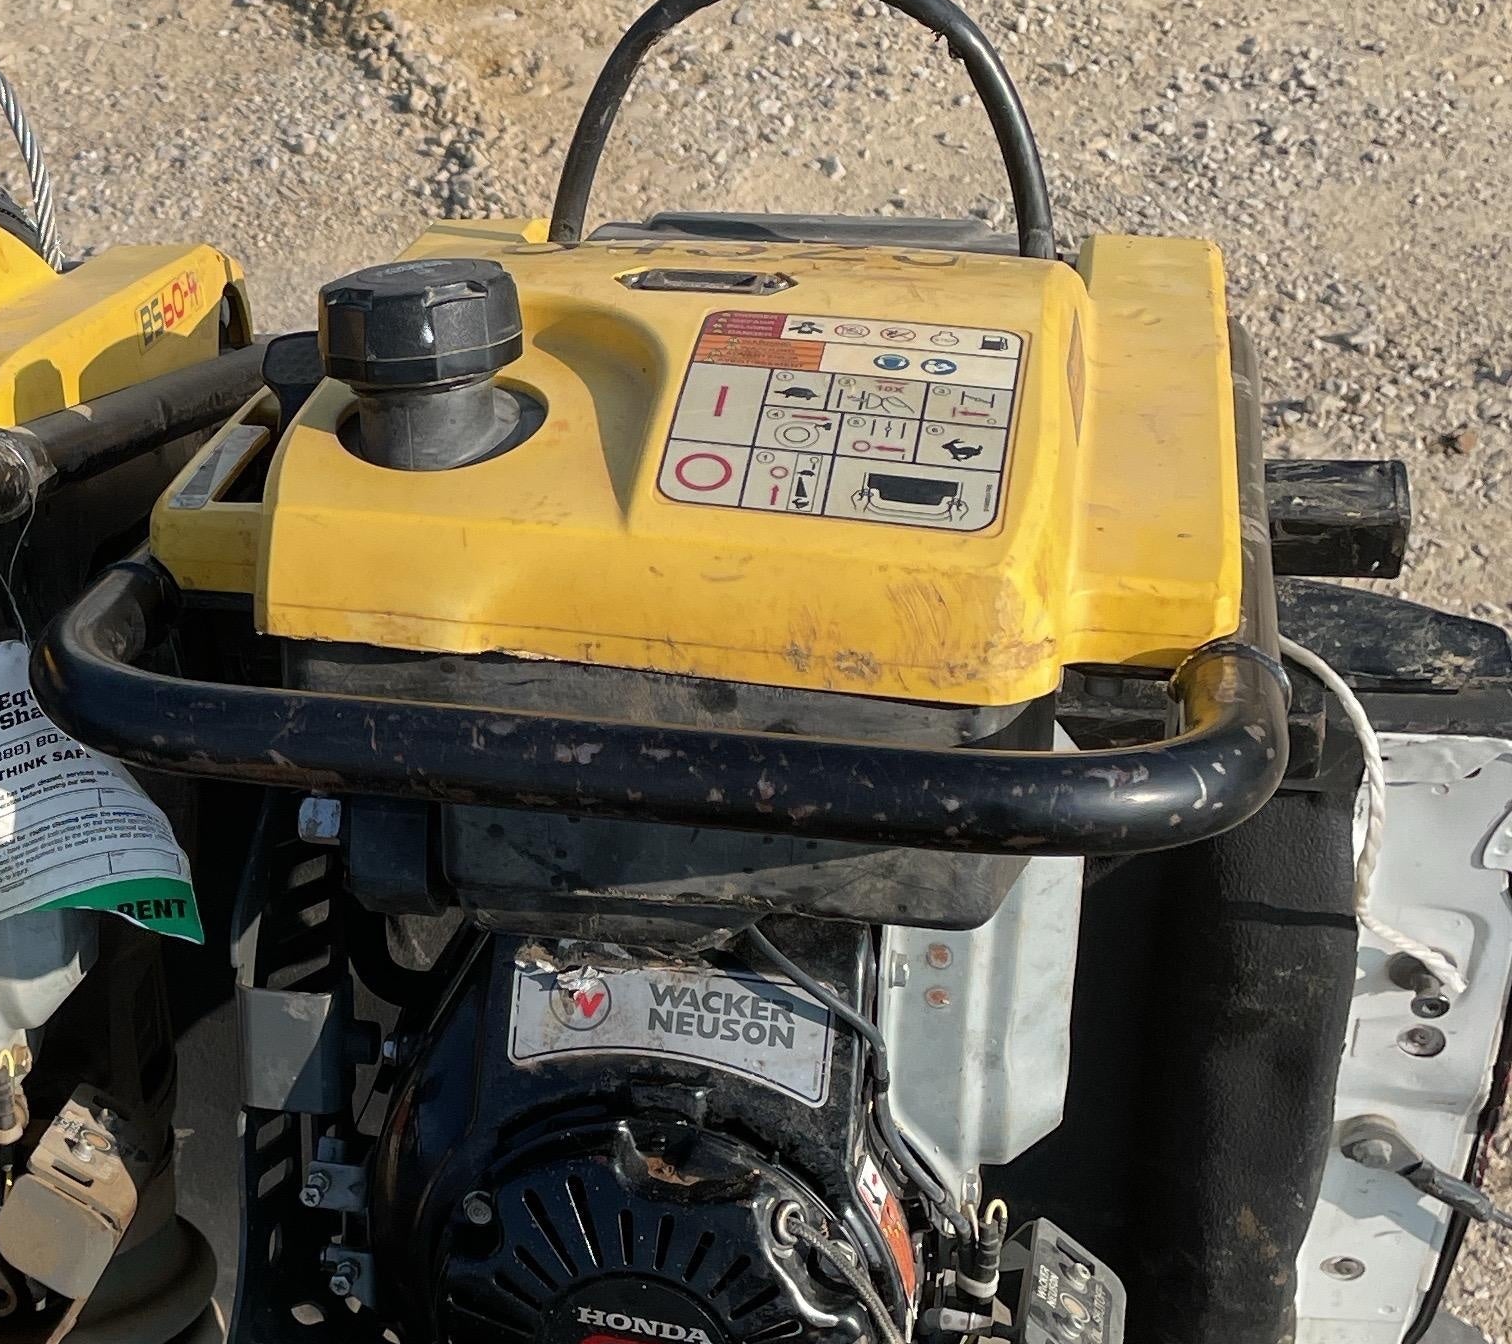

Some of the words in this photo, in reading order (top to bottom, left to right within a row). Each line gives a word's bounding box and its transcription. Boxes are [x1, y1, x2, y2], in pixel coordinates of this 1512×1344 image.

[117, 898, 187, 920] RENT
[649, 983, 796, 1026] WACKER
[648, 1006, 795, 1050] NEUSON
